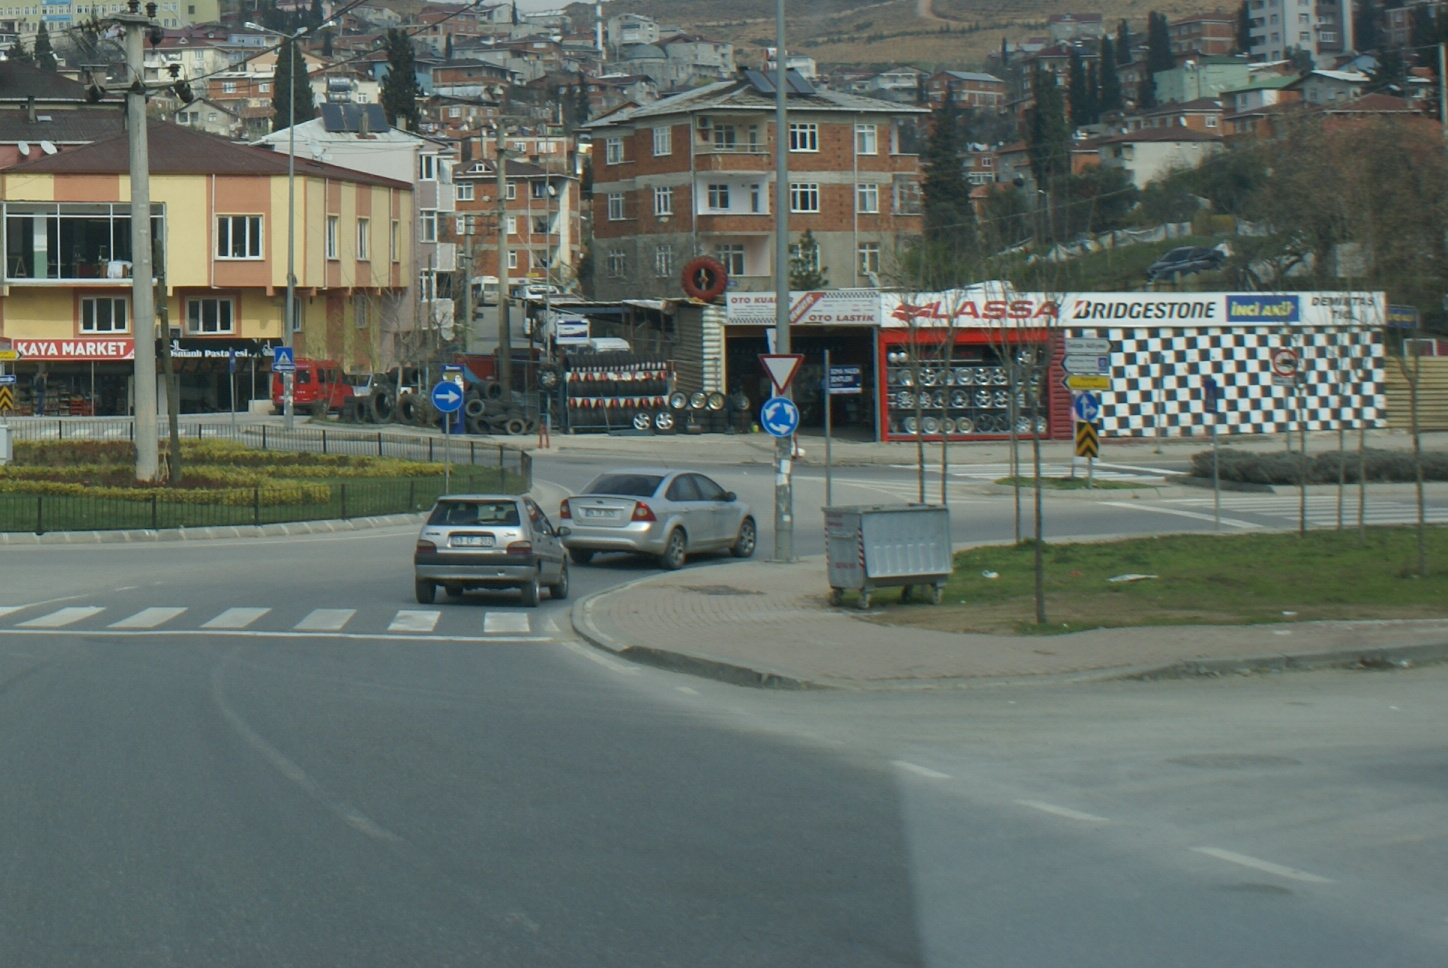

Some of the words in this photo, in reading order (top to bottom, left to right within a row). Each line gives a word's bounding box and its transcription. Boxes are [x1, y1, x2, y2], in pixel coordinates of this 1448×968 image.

[930, 300, 1059, 319] LASSA
[1072, 300, 1216, 319] BRIDGESTONE
[808, 314, 832, 322] OTO
[17, 342, 58, 355] KAYA
[62, 342, 126, 355] MARKET
[170, 349, 202, 358] smanlı
[204, 348, 248, 358] Pastaesi
